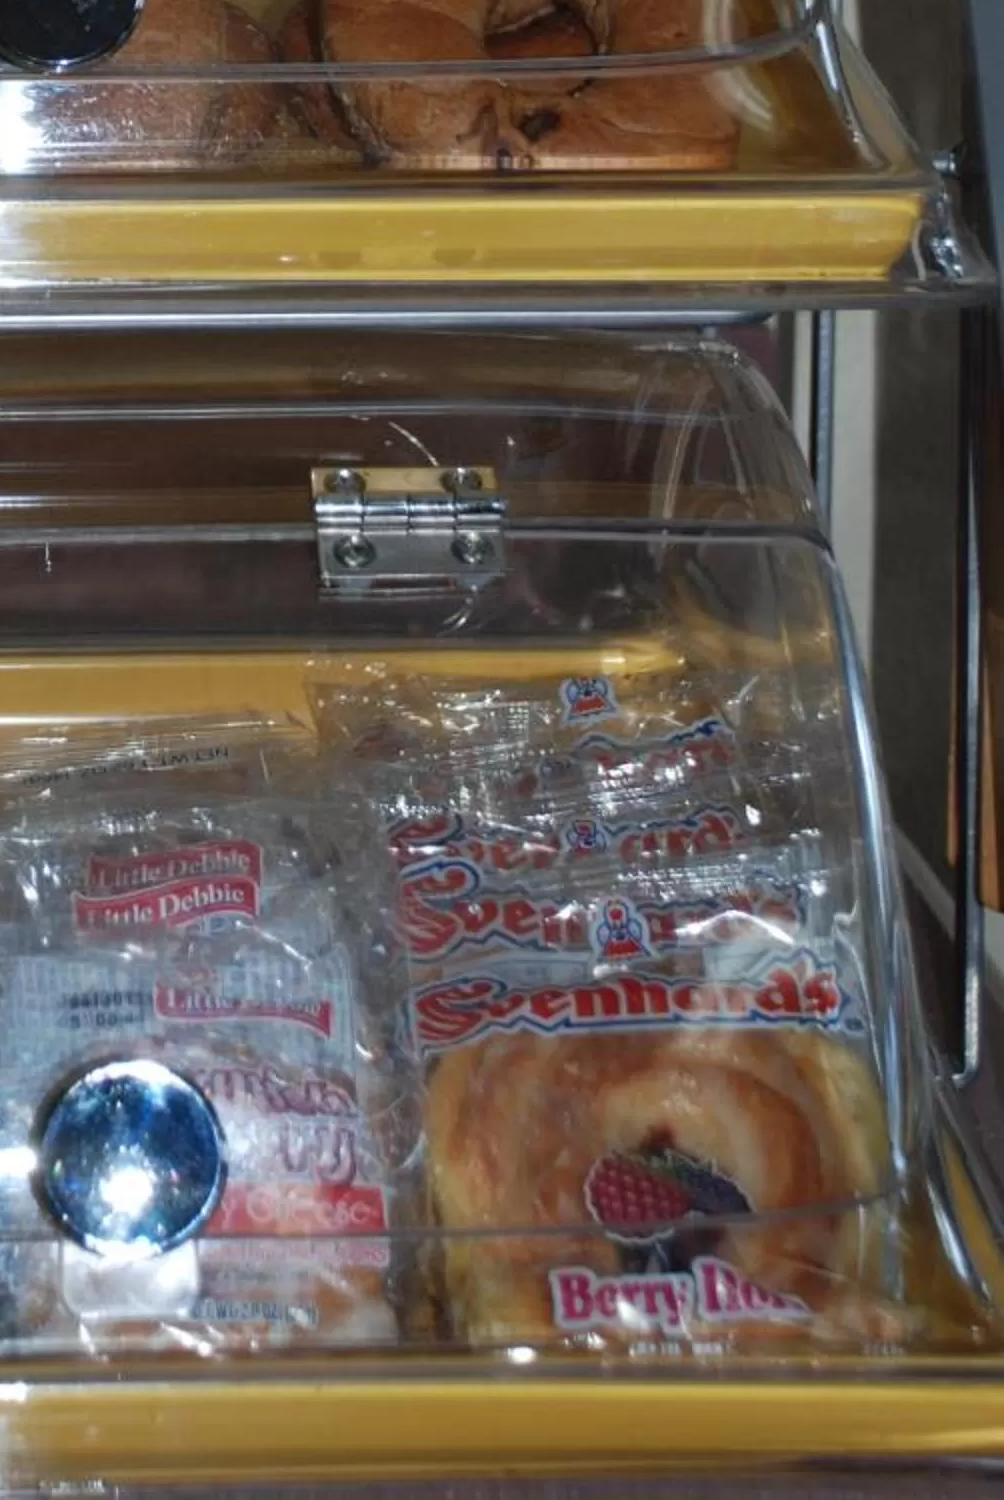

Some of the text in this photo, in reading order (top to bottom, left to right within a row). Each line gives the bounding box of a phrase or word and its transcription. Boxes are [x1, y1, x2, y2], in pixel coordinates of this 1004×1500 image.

[167, 849, 251, 878] Debbie
[87, 882, 245, 927] Little Debbie
[556, 1273, 688, 1327] Berry
